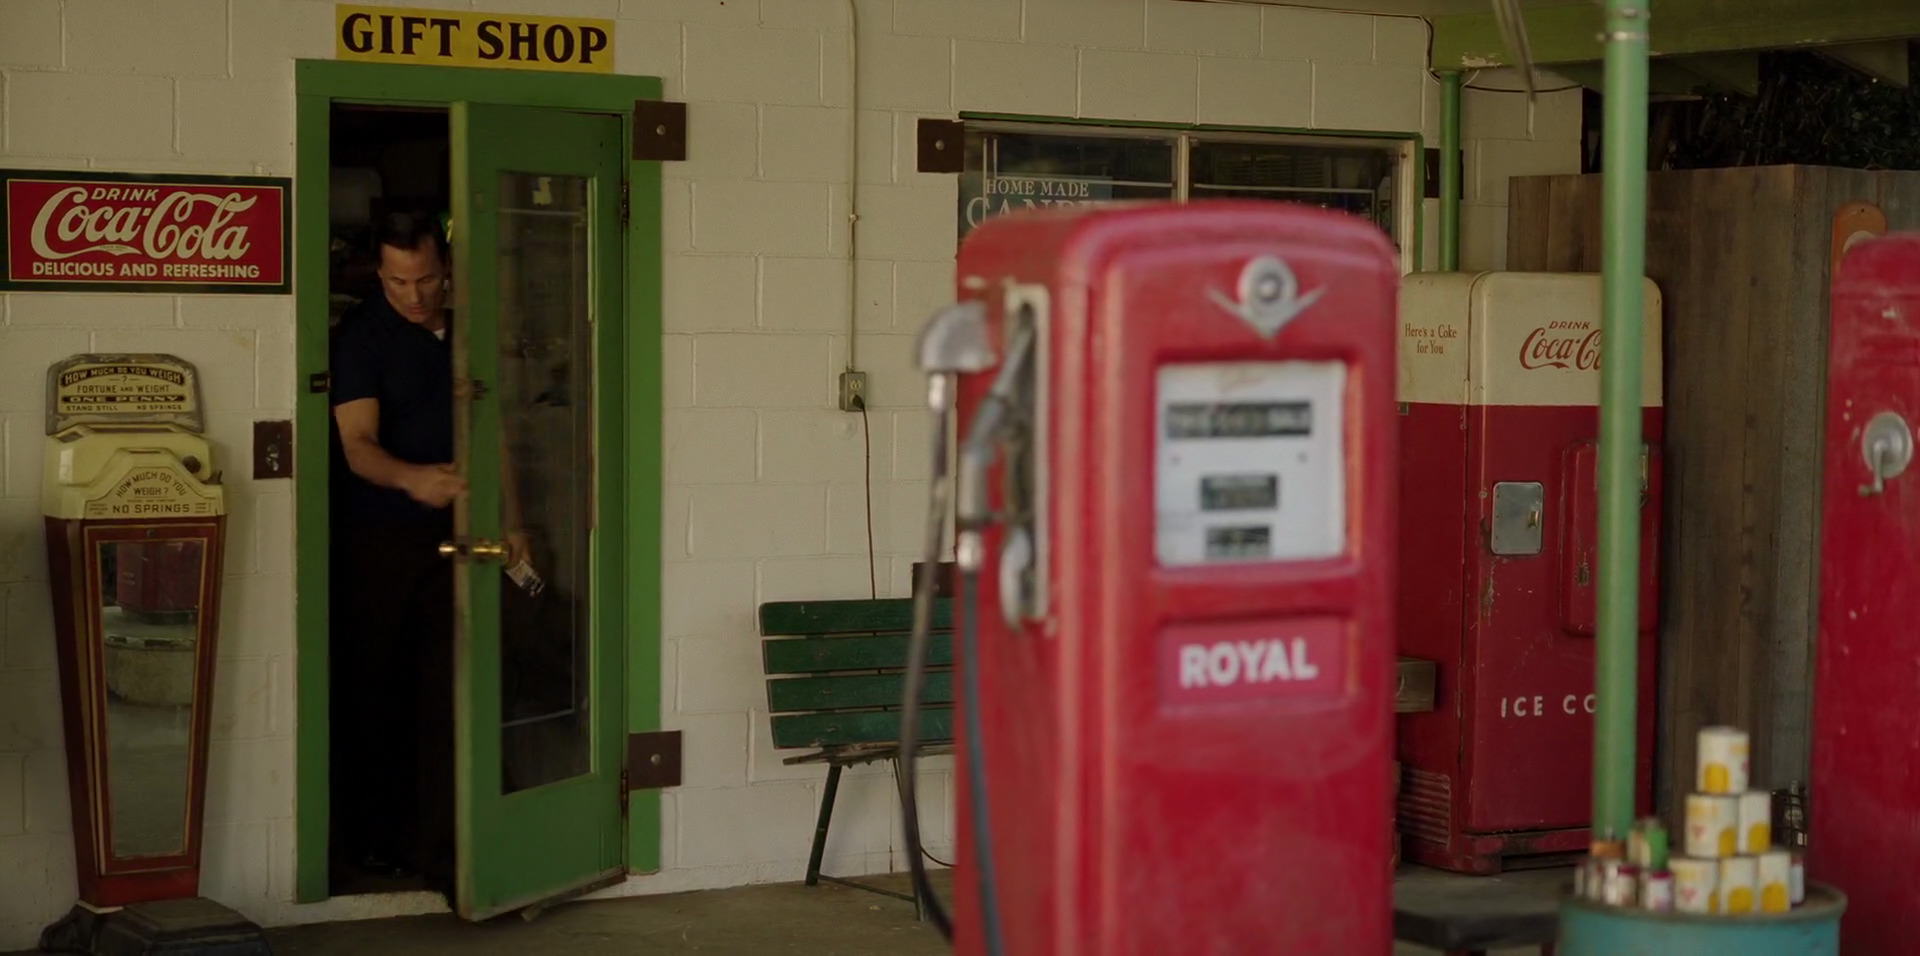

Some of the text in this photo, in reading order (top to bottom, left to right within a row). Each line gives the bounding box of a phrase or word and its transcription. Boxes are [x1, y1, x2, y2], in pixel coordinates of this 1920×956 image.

[342, 13, 607, 64] GIFT SHOP
[91, 187, 160, 202] DRINK
[986, 179, 1089, 197] HOME MADE
[31, 186, 258, 260] Coca-Cola
[33, 262, 260, 278] DELICIOUS AND REFRESHING
[1405, 322, 1457, 338] Here's a Coke
[1549, 321, 1590, 330] DRINK
[1417, 340, 1444, 354] for You
[1519, 327, 1601, 370] Coca-C
[65, 371, 88, 385] HOW
[91, 367, 115, 377] MUCH
[130, 367, 147, 376] YOU
[150, 369, 181, 384] WEIGH
[77, 385, 117, 393] FORTUNE
[136, 384, 169, 393] WEIGHT
[116, 472, 187, 498] HOW MUCH DO YOU
[134, 487, 161, 496] WEIGH
[112, 504, 129, 513] NO
[135, 503, 190, 513] SPRINGS
[1180, 637, 1317, 688] ROYAL
[1501, 693, 1598, 718] ICE CO
